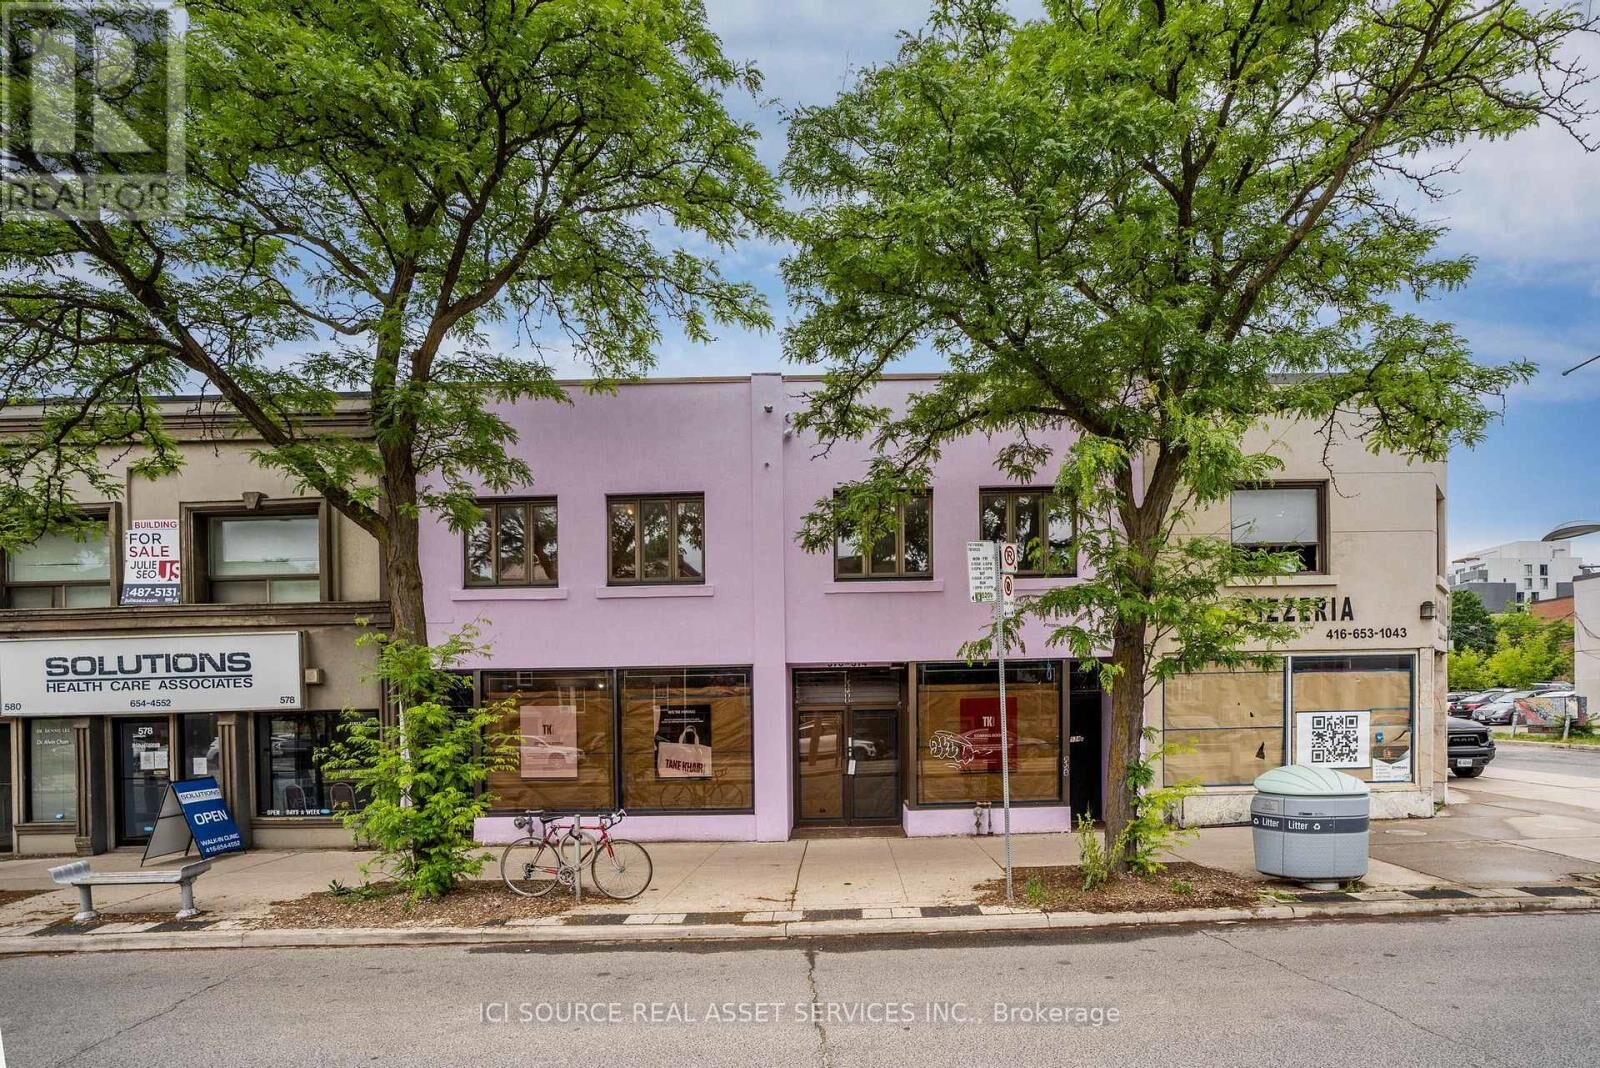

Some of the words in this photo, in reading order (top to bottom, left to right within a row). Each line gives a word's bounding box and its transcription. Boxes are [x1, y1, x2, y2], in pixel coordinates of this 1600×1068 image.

[134, 521, 177, 529] BUILDING
[129, 533, 162, 545] FOR
[129, 546, 170, 558] SALE
[130, 561, 157, 570] JULIE
[136, 570, 157, 579] SEO
[129, 587, 177, 597] 487-5131
[1241, 596, 1354, 623] ZZERIA
[1326, 628, 1407, 640] 416-653-1043
[45, 652, 251, 677] SOLUTIONS
[46, 681, 102, 693] HEALTH
[110, 679, 151, 692] CARE
[158, 677, 253, 691] ASSOCIATES
[130, 699, 171, 708] 654-4552
[279, 696, 295, 704] 578
[4, 702, 22, 711] 580
[138, 726, 153, 735] 578
[193, 809, 229, 826] OPEN
[1262, 816, 1280, 828] Litter
[1288, 819, 1308, 830] Litter
